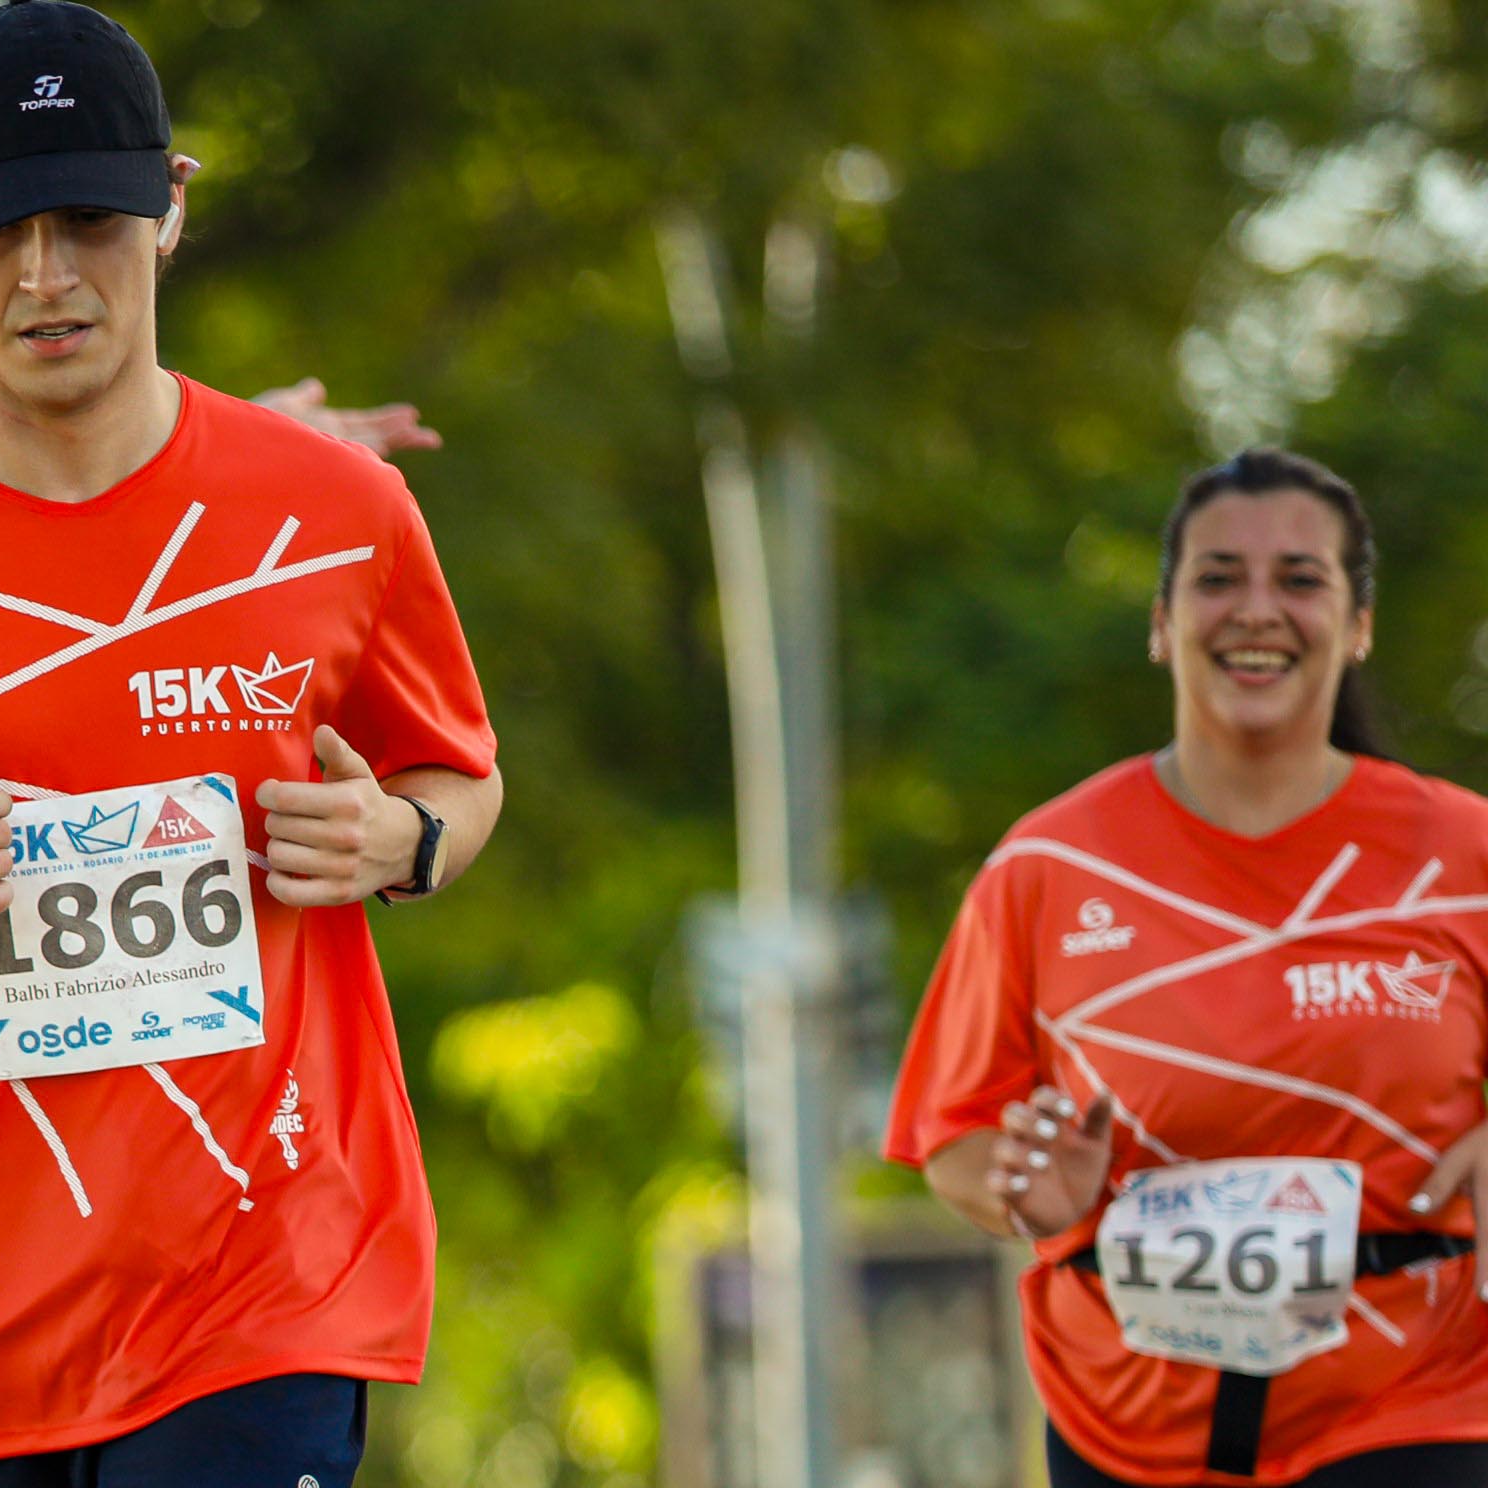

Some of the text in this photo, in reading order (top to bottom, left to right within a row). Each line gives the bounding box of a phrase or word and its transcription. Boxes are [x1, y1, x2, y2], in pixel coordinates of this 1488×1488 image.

[19, 98, 75, 112] TOPPER
[128, 666, 231, 719] 15K
[141, 719, 293, 736] PUERTO NORTE
[9, 823, 58, 864] 5K
[156, 815, 197, 840] 15K
[20, 865, 49, 877] NORTE
[84, 855, 124, 868] ROSARIO
[147, 851, 158, 859] DE
[164, 848, 189, 858] ABRIL
[5, 960, 226, 1004] Balbi Fabrizio Alessandro
[1283, 961, 1377, 1008] 15K
[18, 1016, 113, 1058] osde
[1114, 1225, 1340, 1294] 1261
